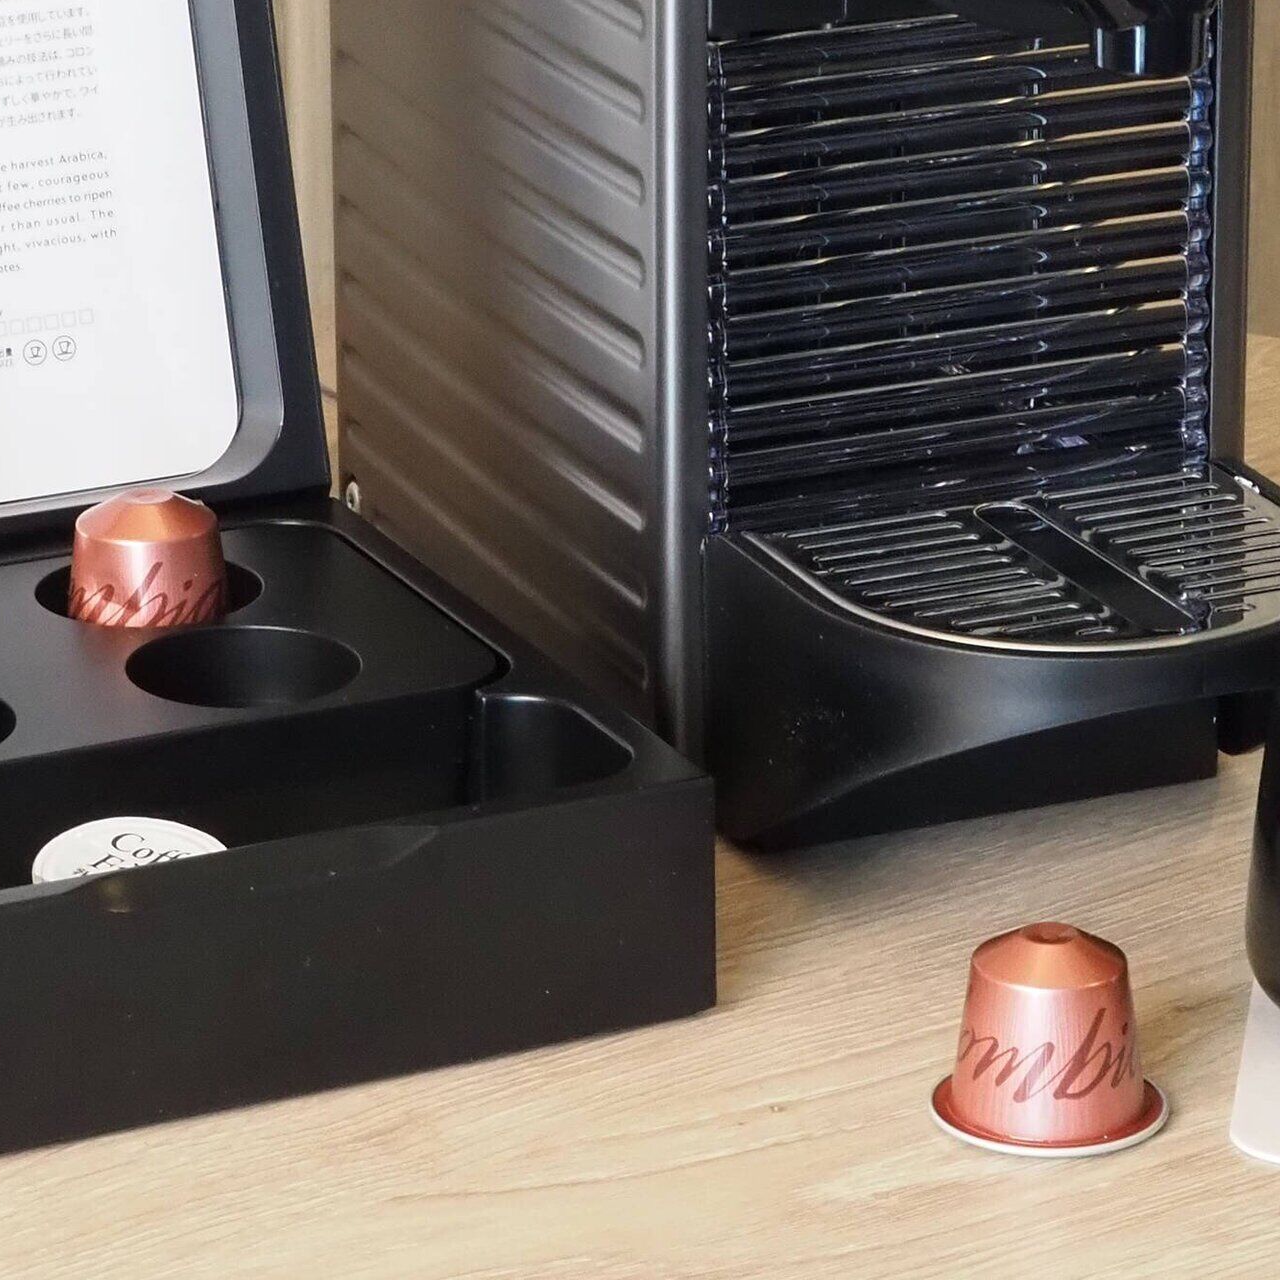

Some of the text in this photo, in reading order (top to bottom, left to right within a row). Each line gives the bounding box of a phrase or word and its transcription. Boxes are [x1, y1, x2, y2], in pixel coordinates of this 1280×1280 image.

[10, 156, 55, 171] harvest
[58, 150, 108, 164] Arabica,
[37, 170, 110, 187] courageous
[22, 195, 67, 209] cherries
[68, 191, 83, 203] to
[83, 186, 113, 202] ripen
[10, 219, 41, 231] than
[89, 207, 116, 220] The
[88, 224, 118, 240] with
